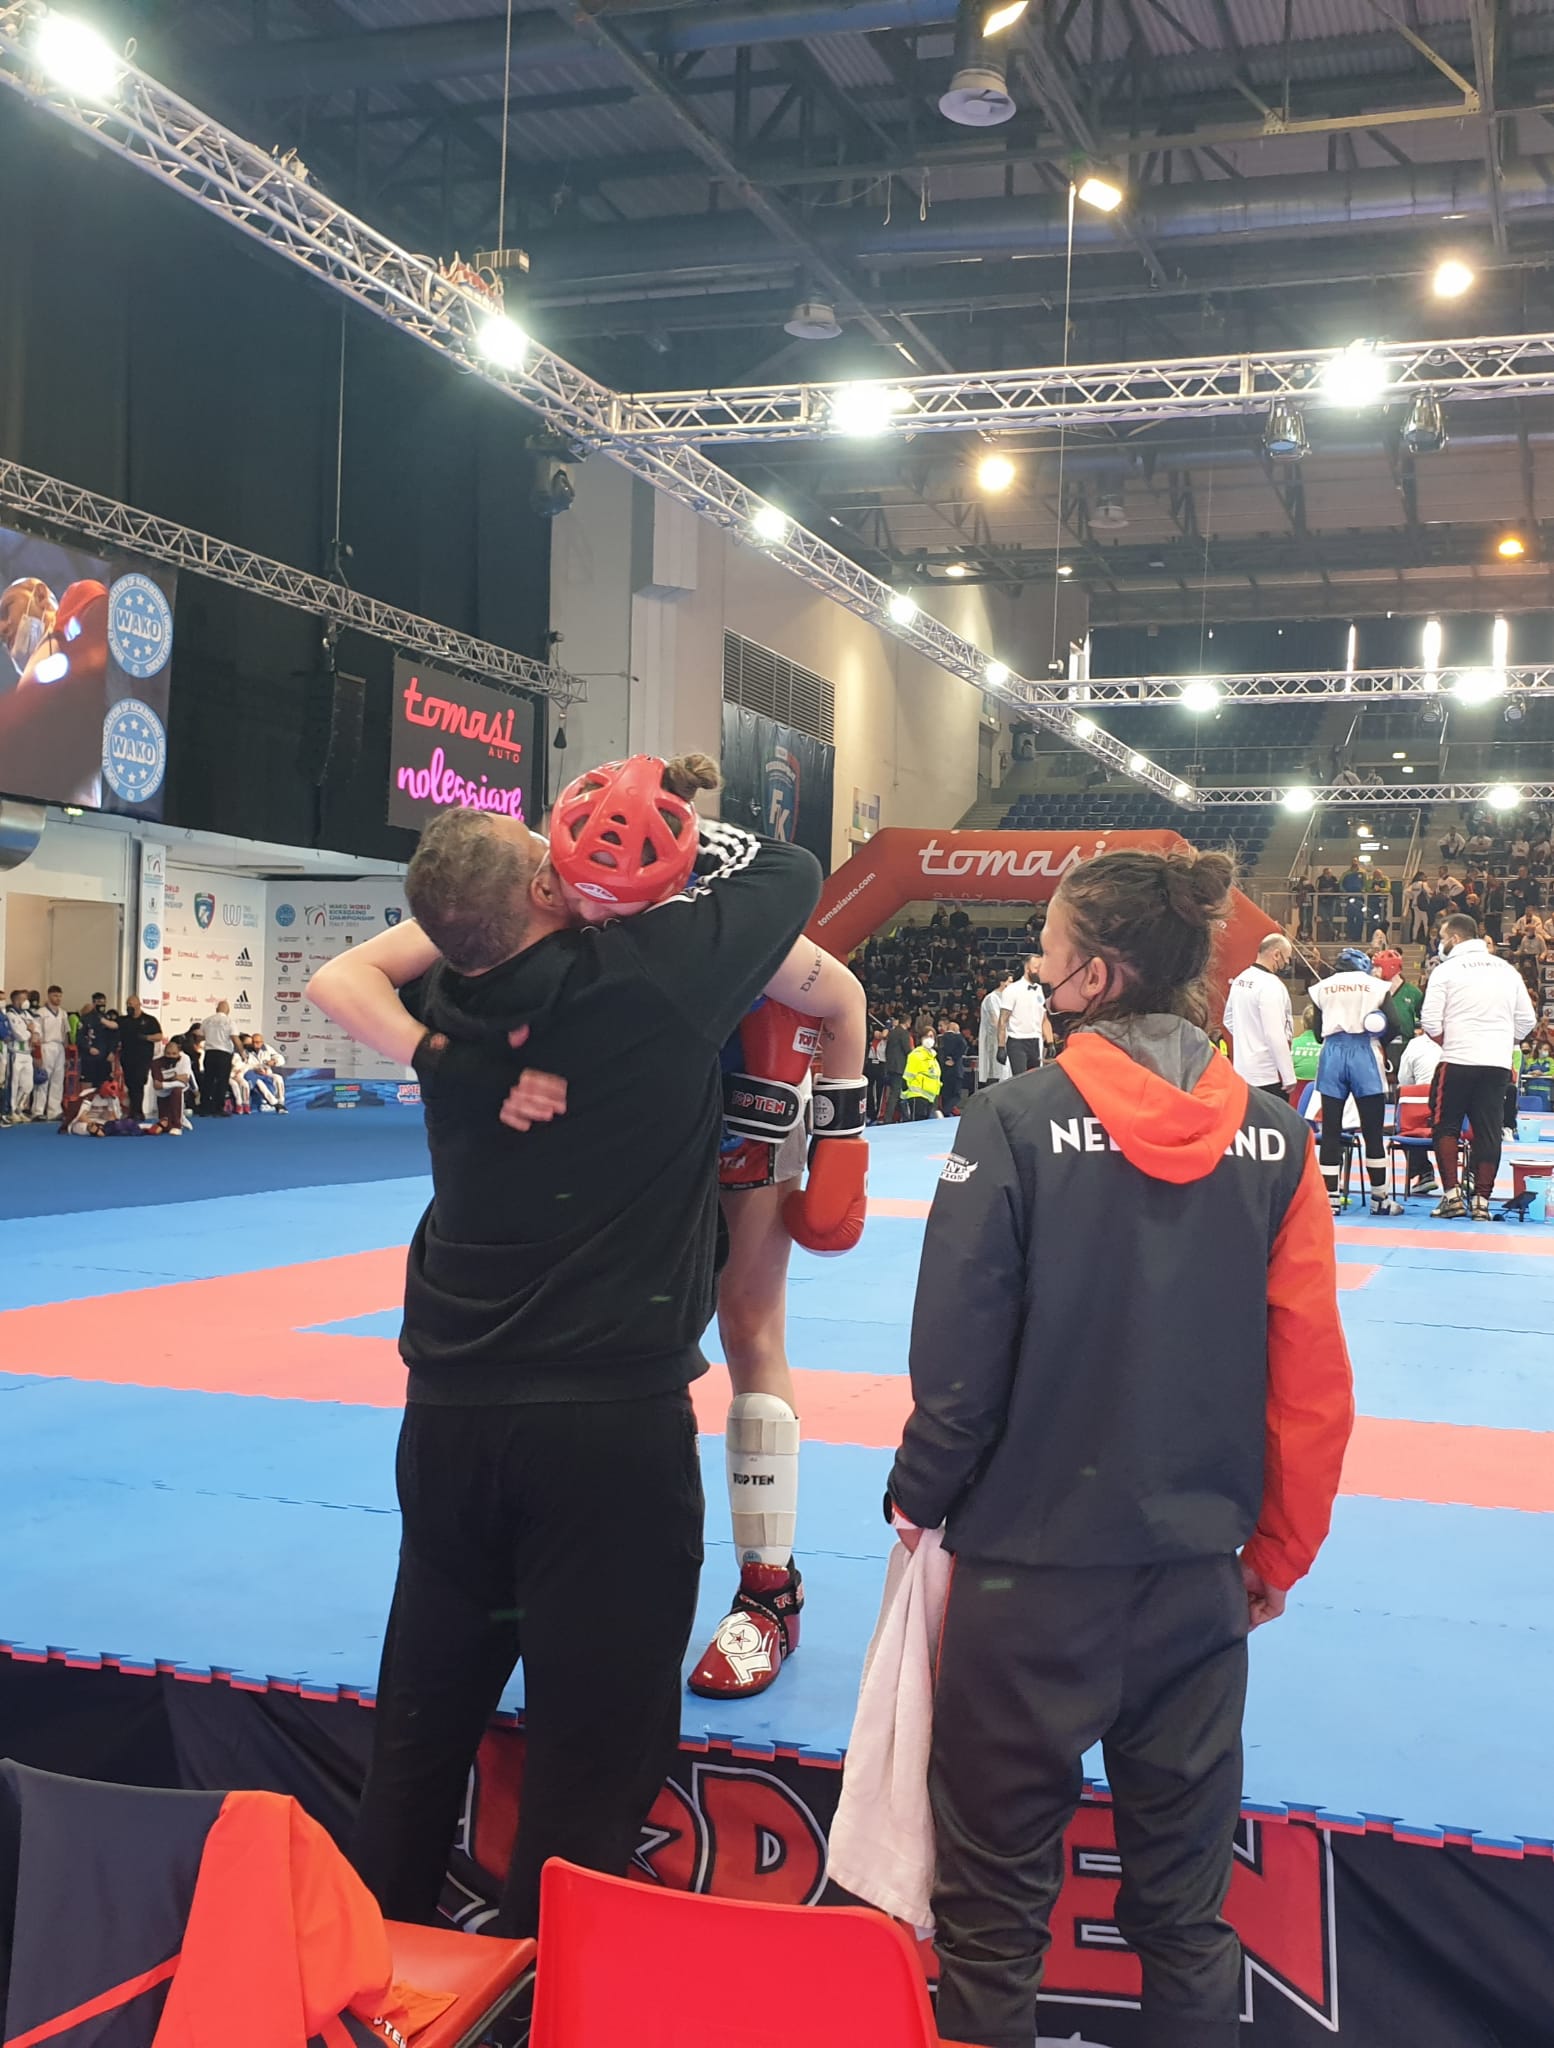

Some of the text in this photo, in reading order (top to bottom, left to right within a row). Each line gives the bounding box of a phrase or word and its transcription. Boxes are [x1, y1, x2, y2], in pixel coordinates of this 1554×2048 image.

[116, 607, 161, 642] WAKO
[404, 677, 521, 752] tomasi
[111, 734, 156, 767] WAKO
[488, 746, 521, 763] AUTO
[817, 872, 877, 927] tomasiauto.com
[731, 1090, 754, 1108] TOP
[755, 1095, 786, 1115] TEN
[733, 1471, 775, 1487] TOP TEN
